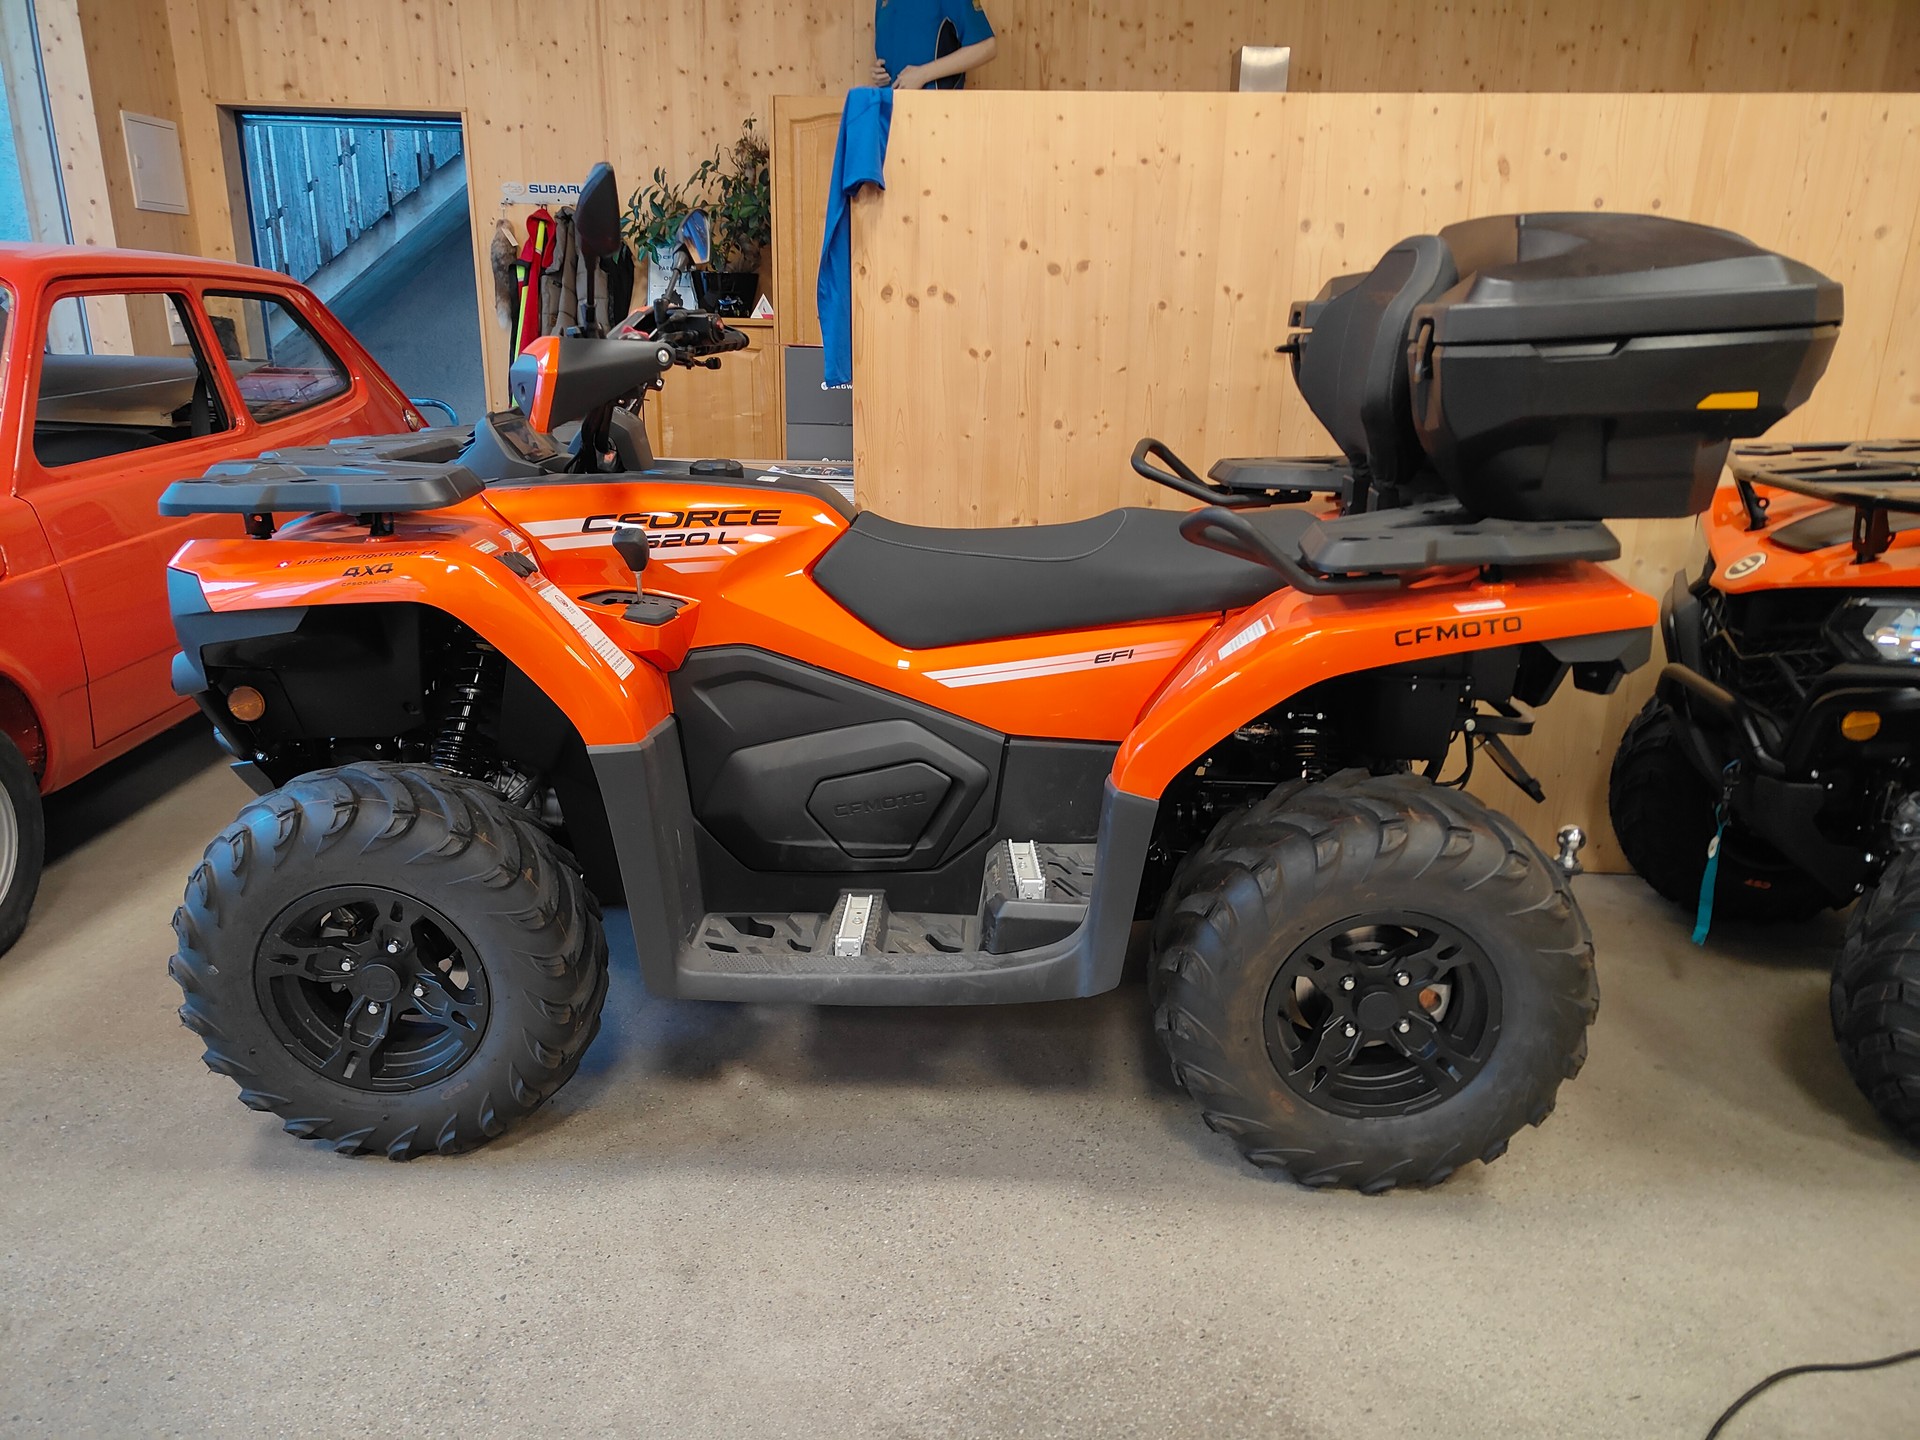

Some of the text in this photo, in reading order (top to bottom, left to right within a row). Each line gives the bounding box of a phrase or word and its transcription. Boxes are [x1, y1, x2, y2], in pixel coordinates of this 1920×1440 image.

[582, 509, 782, 534] CFORCE
[646, 531, 739, 549] 520 L
[1394, 615, 1522, 647] CFMOTO
[1093, 648, 1135, 664] EFI
[833, 791, 929, 818] CFMOTO
